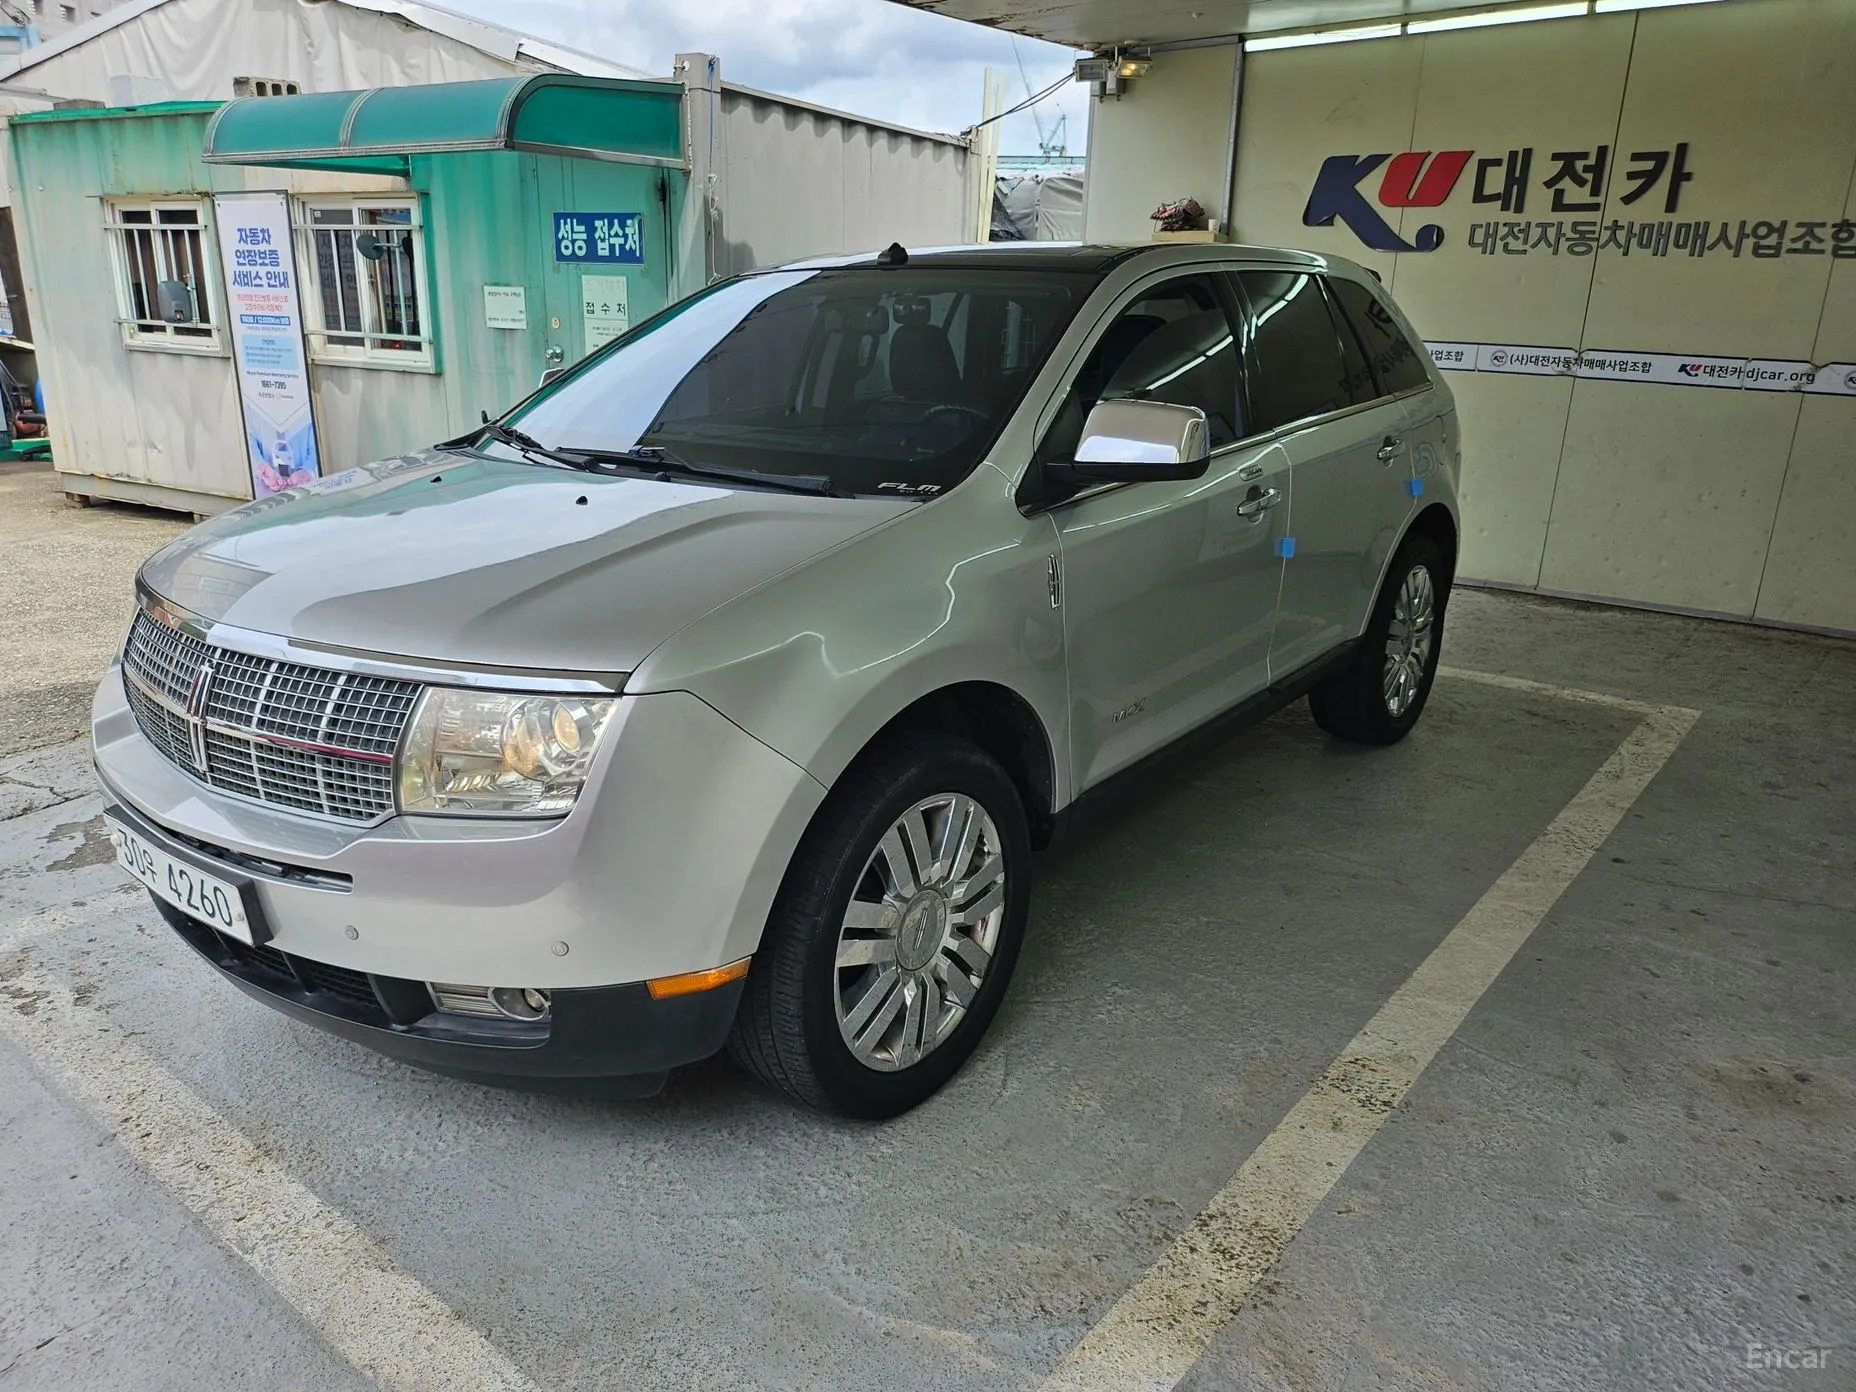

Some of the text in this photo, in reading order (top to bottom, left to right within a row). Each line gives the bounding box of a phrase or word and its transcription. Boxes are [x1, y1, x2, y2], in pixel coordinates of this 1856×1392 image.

[1472, 142, 1693, 214] 대전카
[236, 227, 271, 246] 자동차
[558, 218, 640, 257] 성능 접수처
[1467, 219, 1856, 259] 대전자동차매매사업조합
[235, 249, 280, 267] 연장보증
[232, 270, 290, 289] 서비스 안내
[1430, 349, 1464, 363] 업조합
[1509, 353, 1653, 374] (사)대전자동차매매사업조합
[1703, 364, 1745, 380] 대전카
[1746, 367, 1816, 384] djcar.org
[877, 482, 942, 492] FLM
[168, 862, 233, 928] 4260
